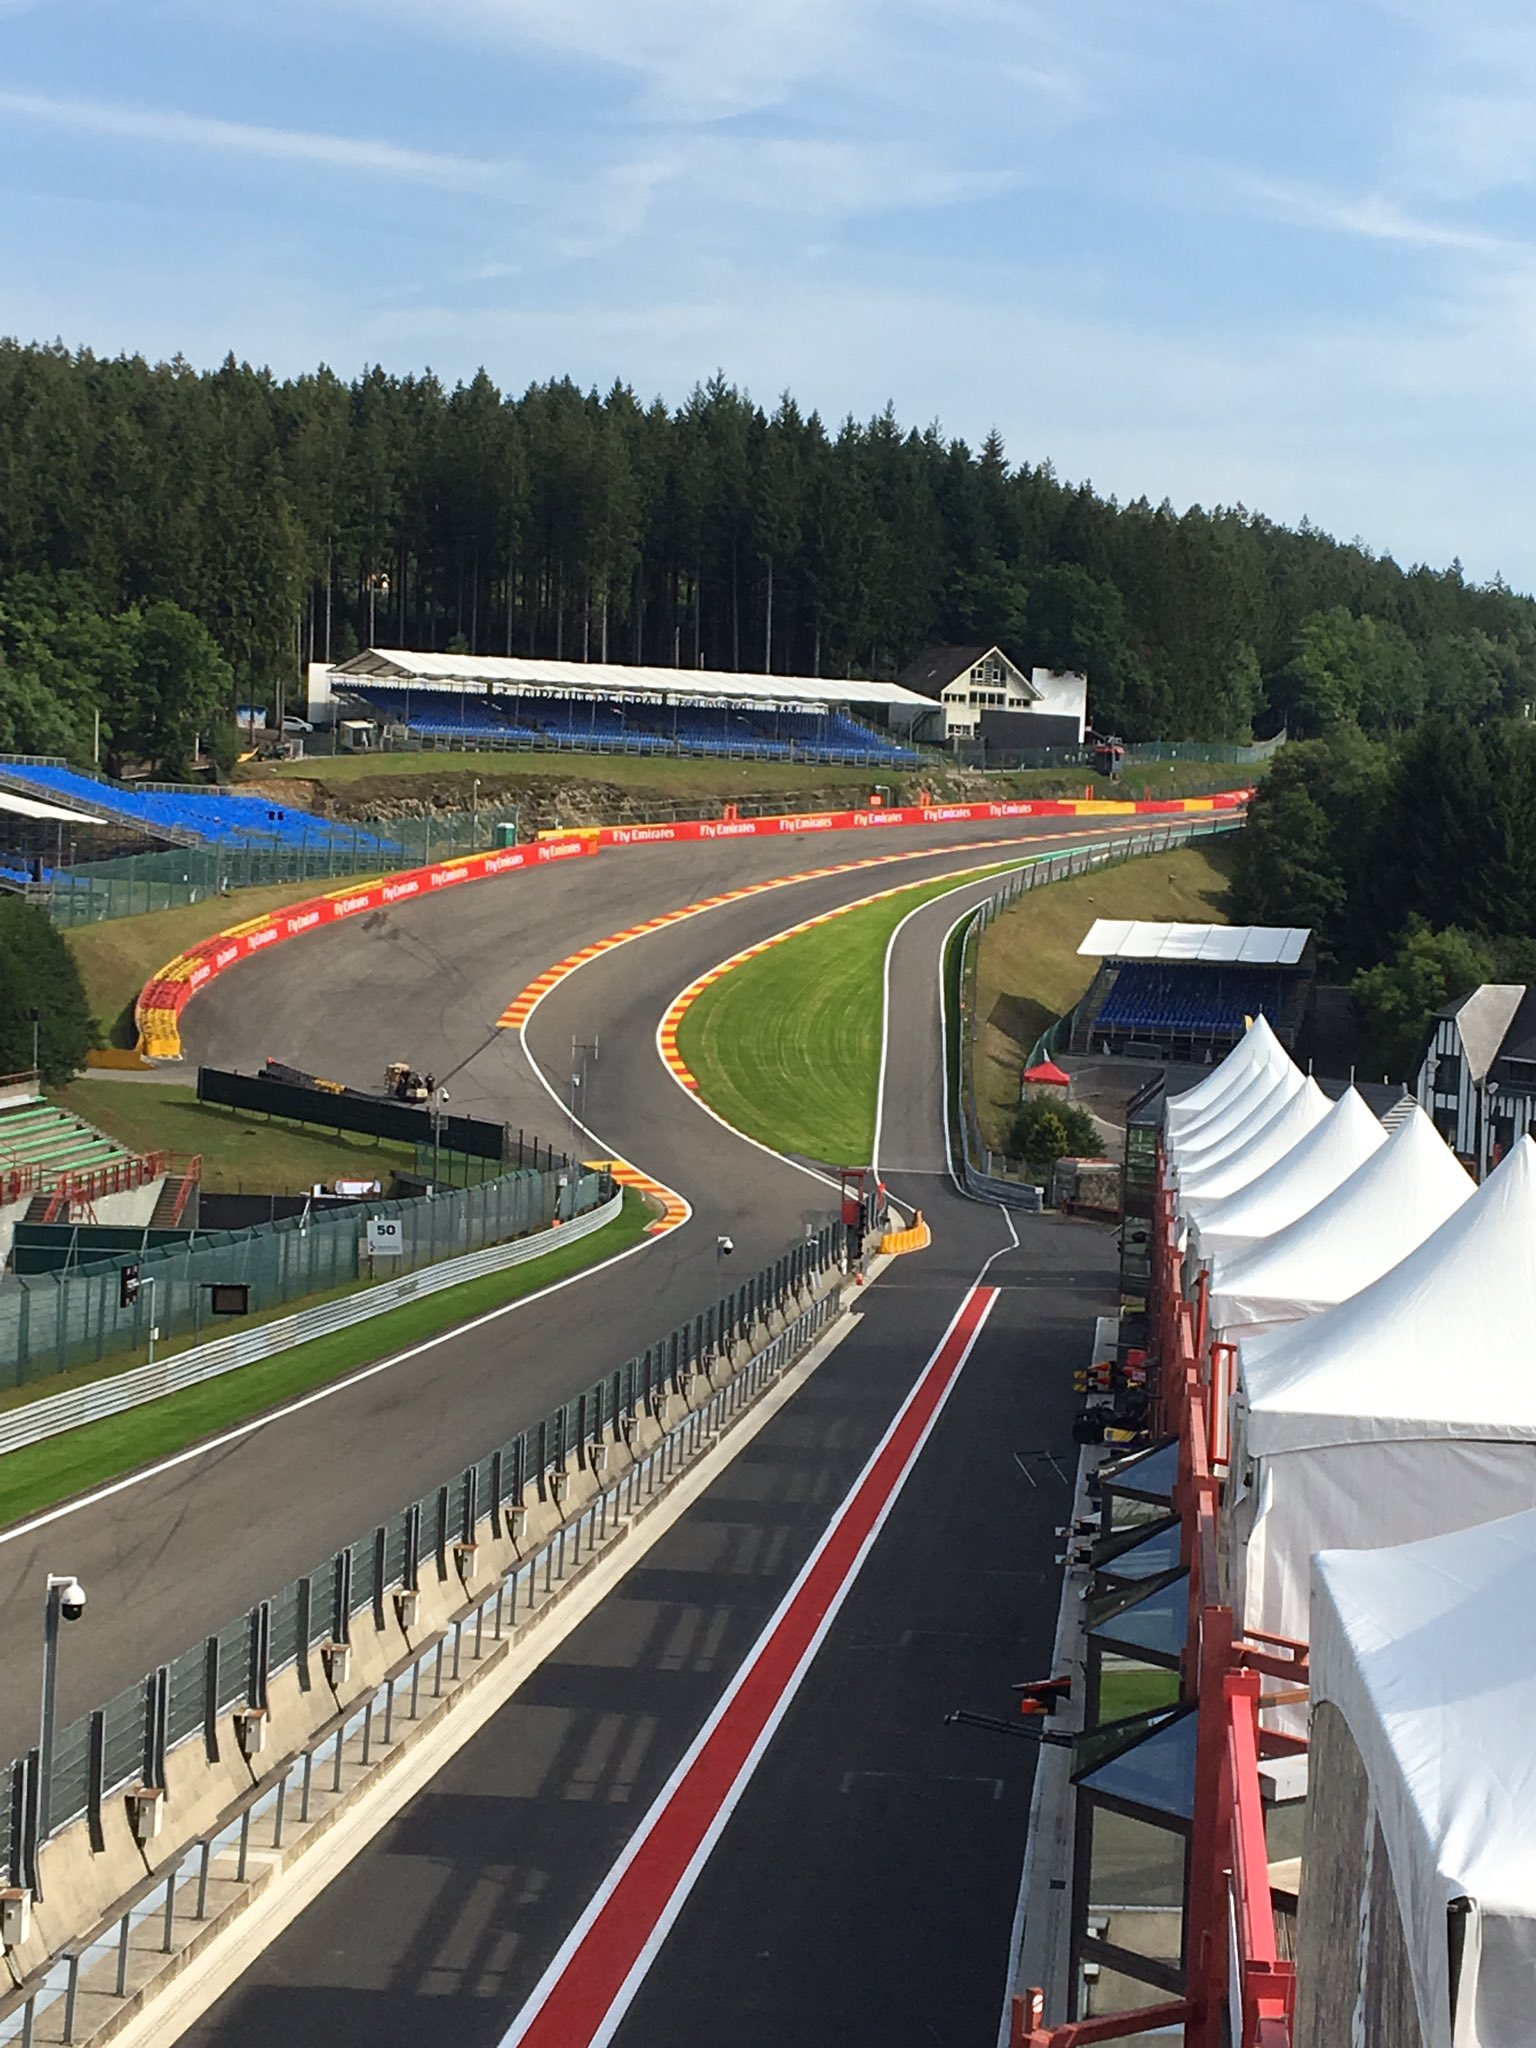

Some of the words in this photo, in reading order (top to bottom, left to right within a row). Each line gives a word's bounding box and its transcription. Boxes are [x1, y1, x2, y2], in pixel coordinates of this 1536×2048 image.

[700, 824, 715, 837] Fly
[716, 822, 755, 835] Emirates
[780, 819, 794, 832] Fly
[795, 817, 832, 830] Emirates
[613, 830, 630, 842] Fly
[632, 828, 675, 840] Emirates
[377, 1224, 396, 1236] 50
